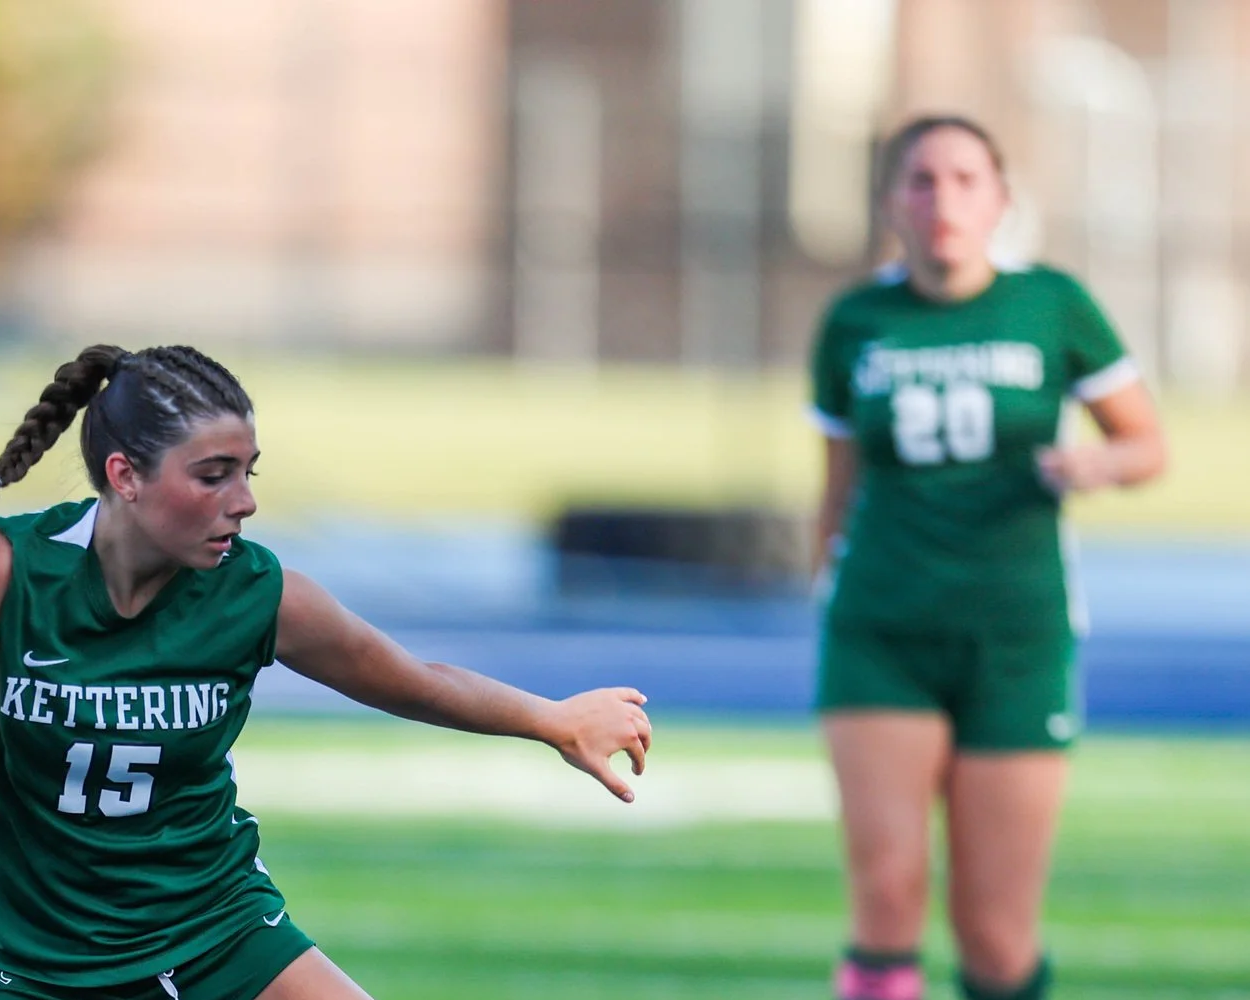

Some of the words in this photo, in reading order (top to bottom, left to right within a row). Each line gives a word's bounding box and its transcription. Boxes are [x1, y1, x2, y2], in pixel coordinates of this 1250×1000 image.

[893, 383, 993, 463] 20
[0, 676, 229, 730] KETTERING
[58, 742, 162, 817] 15
